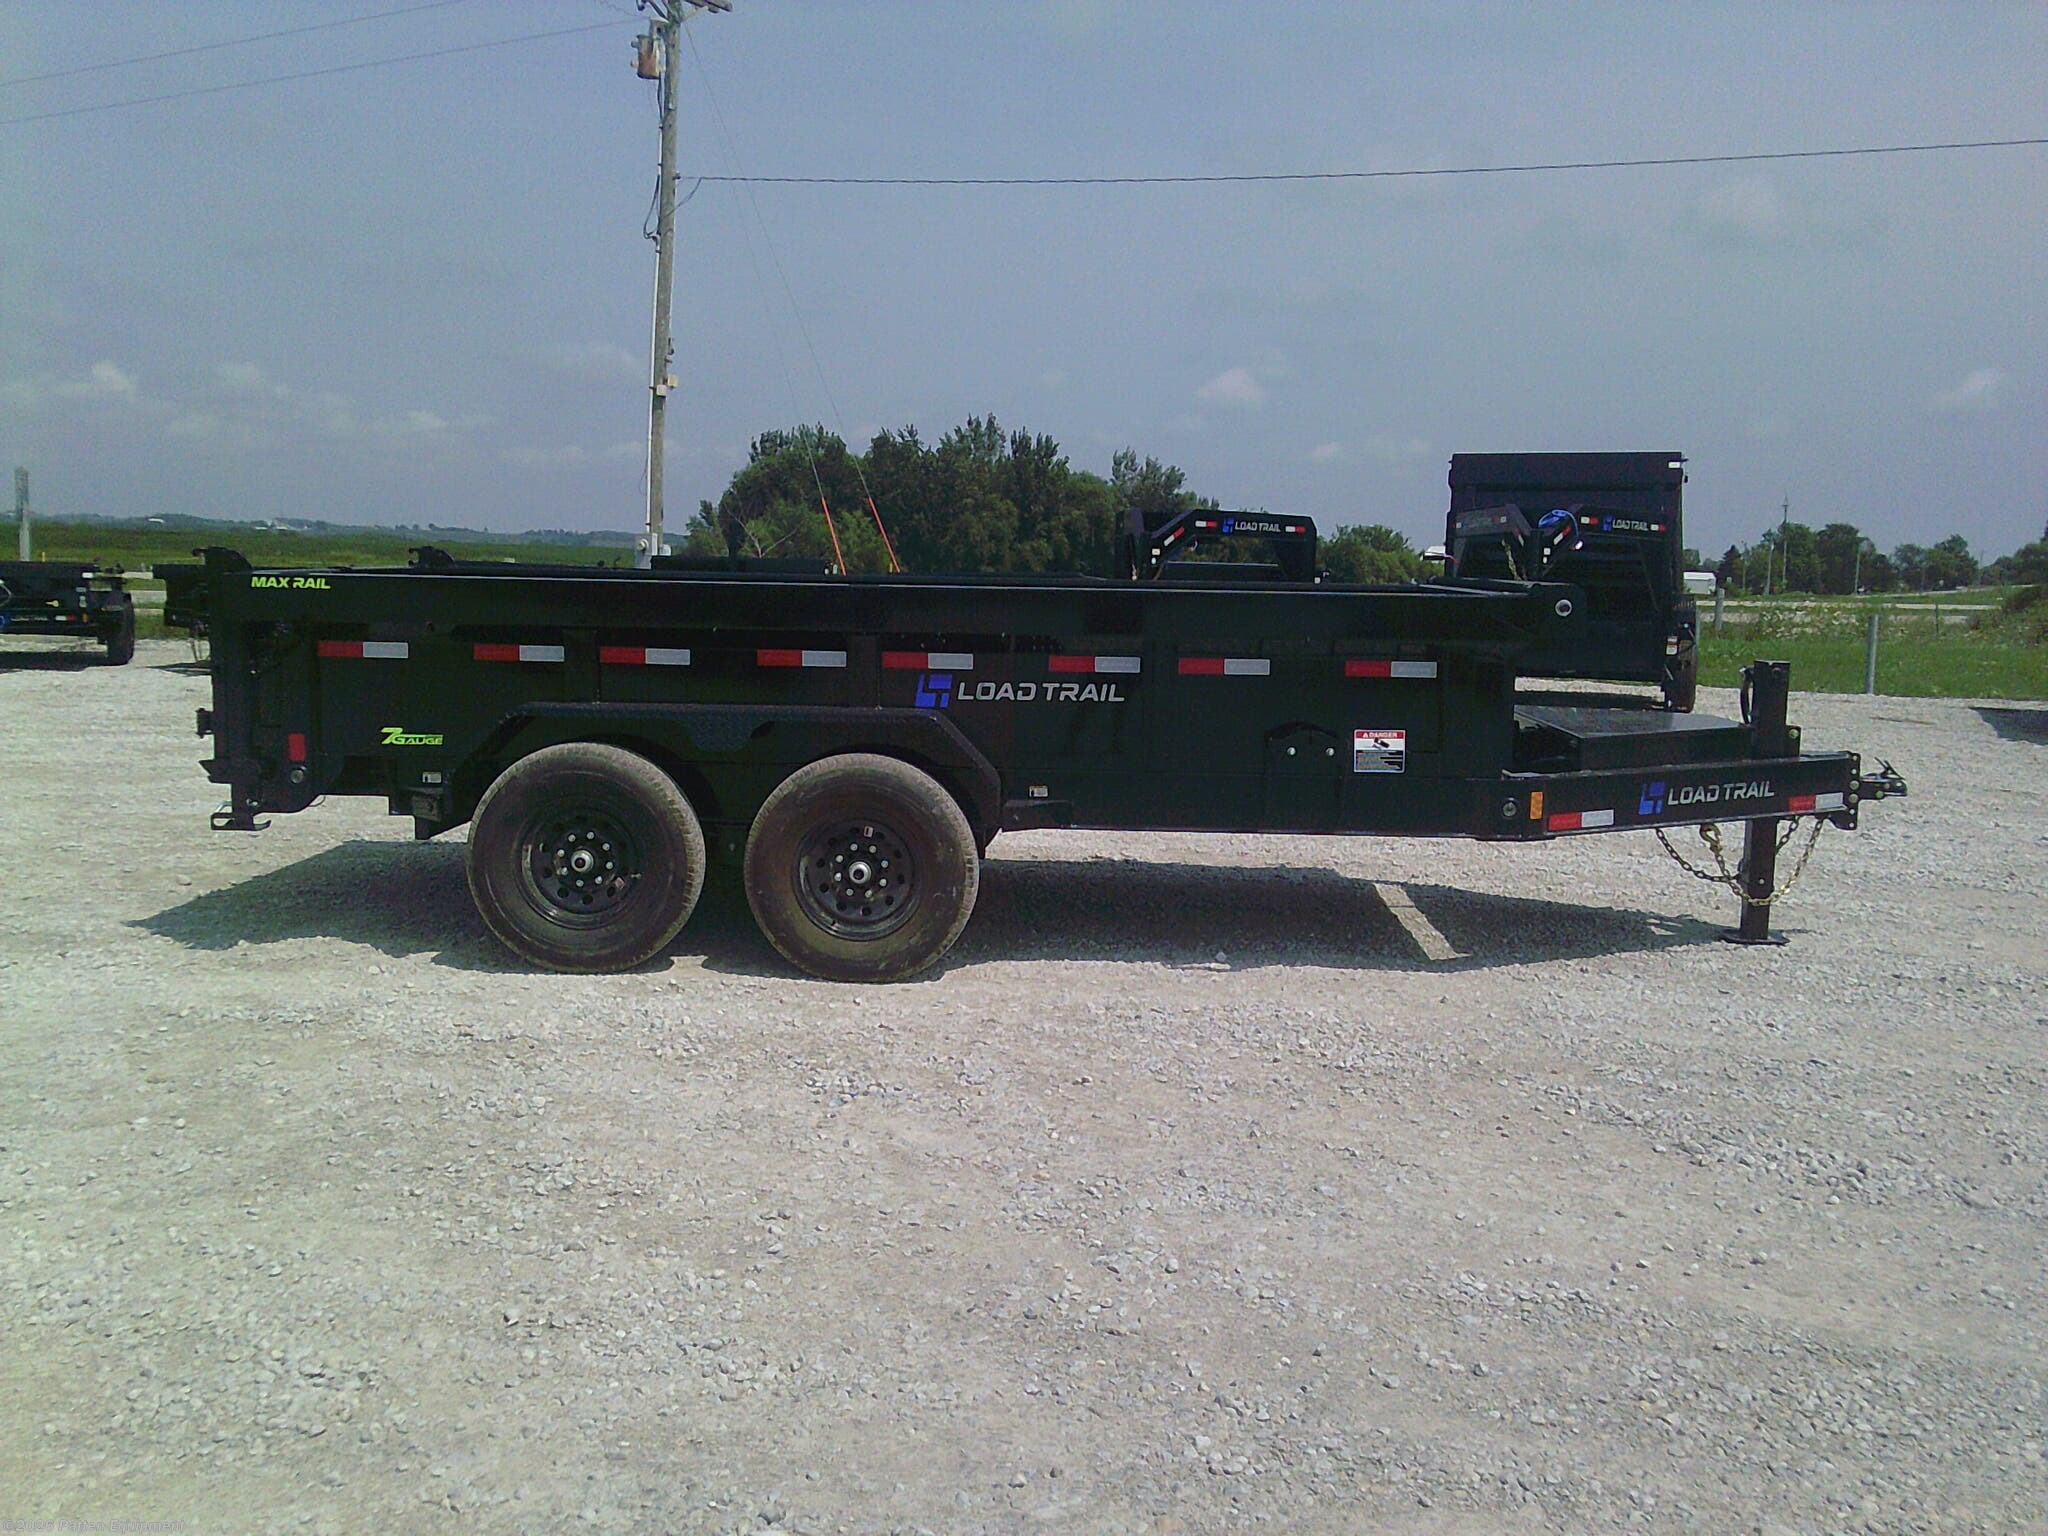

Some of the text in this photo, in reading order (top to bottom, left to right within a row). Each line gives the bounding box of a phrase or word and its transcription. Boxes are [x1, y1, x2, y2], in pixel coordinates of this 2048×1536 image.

[1234, 521, 1281, 533] LOAD TRAIL
[1612, 519, 1630, 530] LOAD
[251, 576, 331, 589] MAX RAIL
[957, 682, 1125, 702] LOAD TRAIL
[1667, 780, 1775, 806] LOAD TRAIL
